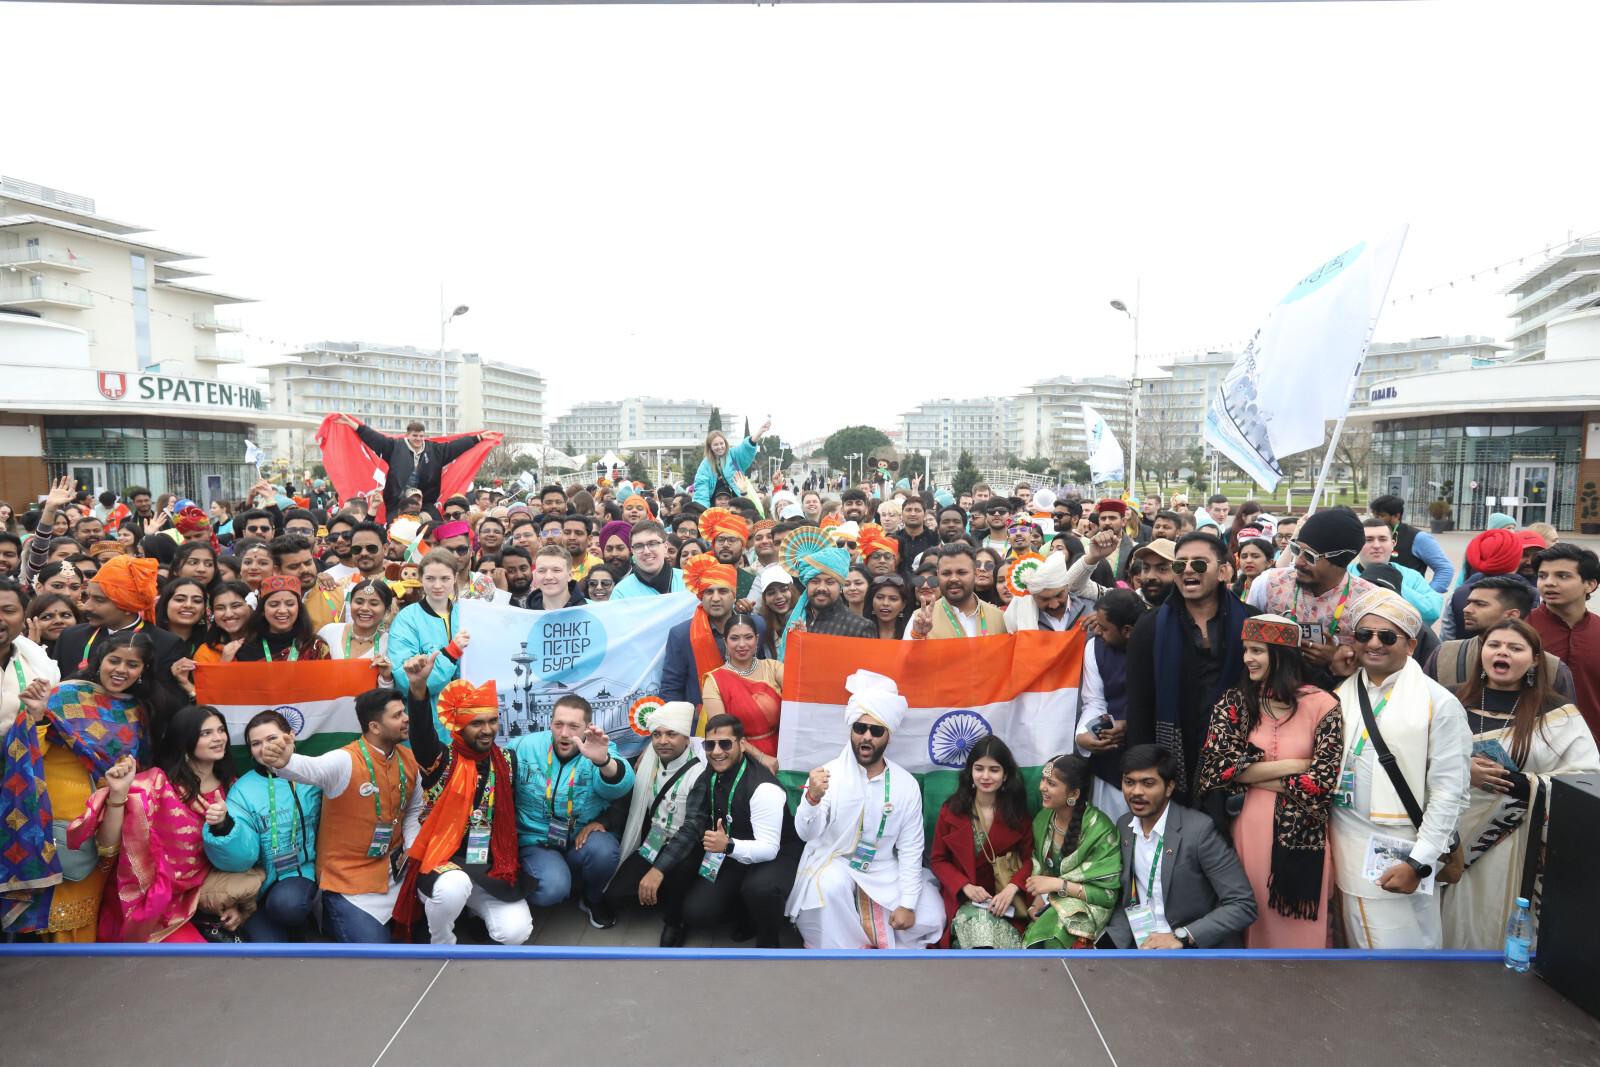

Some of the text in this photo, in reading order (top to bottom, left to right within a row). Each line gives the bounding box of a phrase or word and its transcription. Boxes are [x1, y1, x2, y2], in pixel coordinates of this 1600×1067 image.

[543, 621, 591, 638] САНКТ
[543, 638, 591, 656] ПЕТЕР
[542, 655, 581, 673] БУРГ
